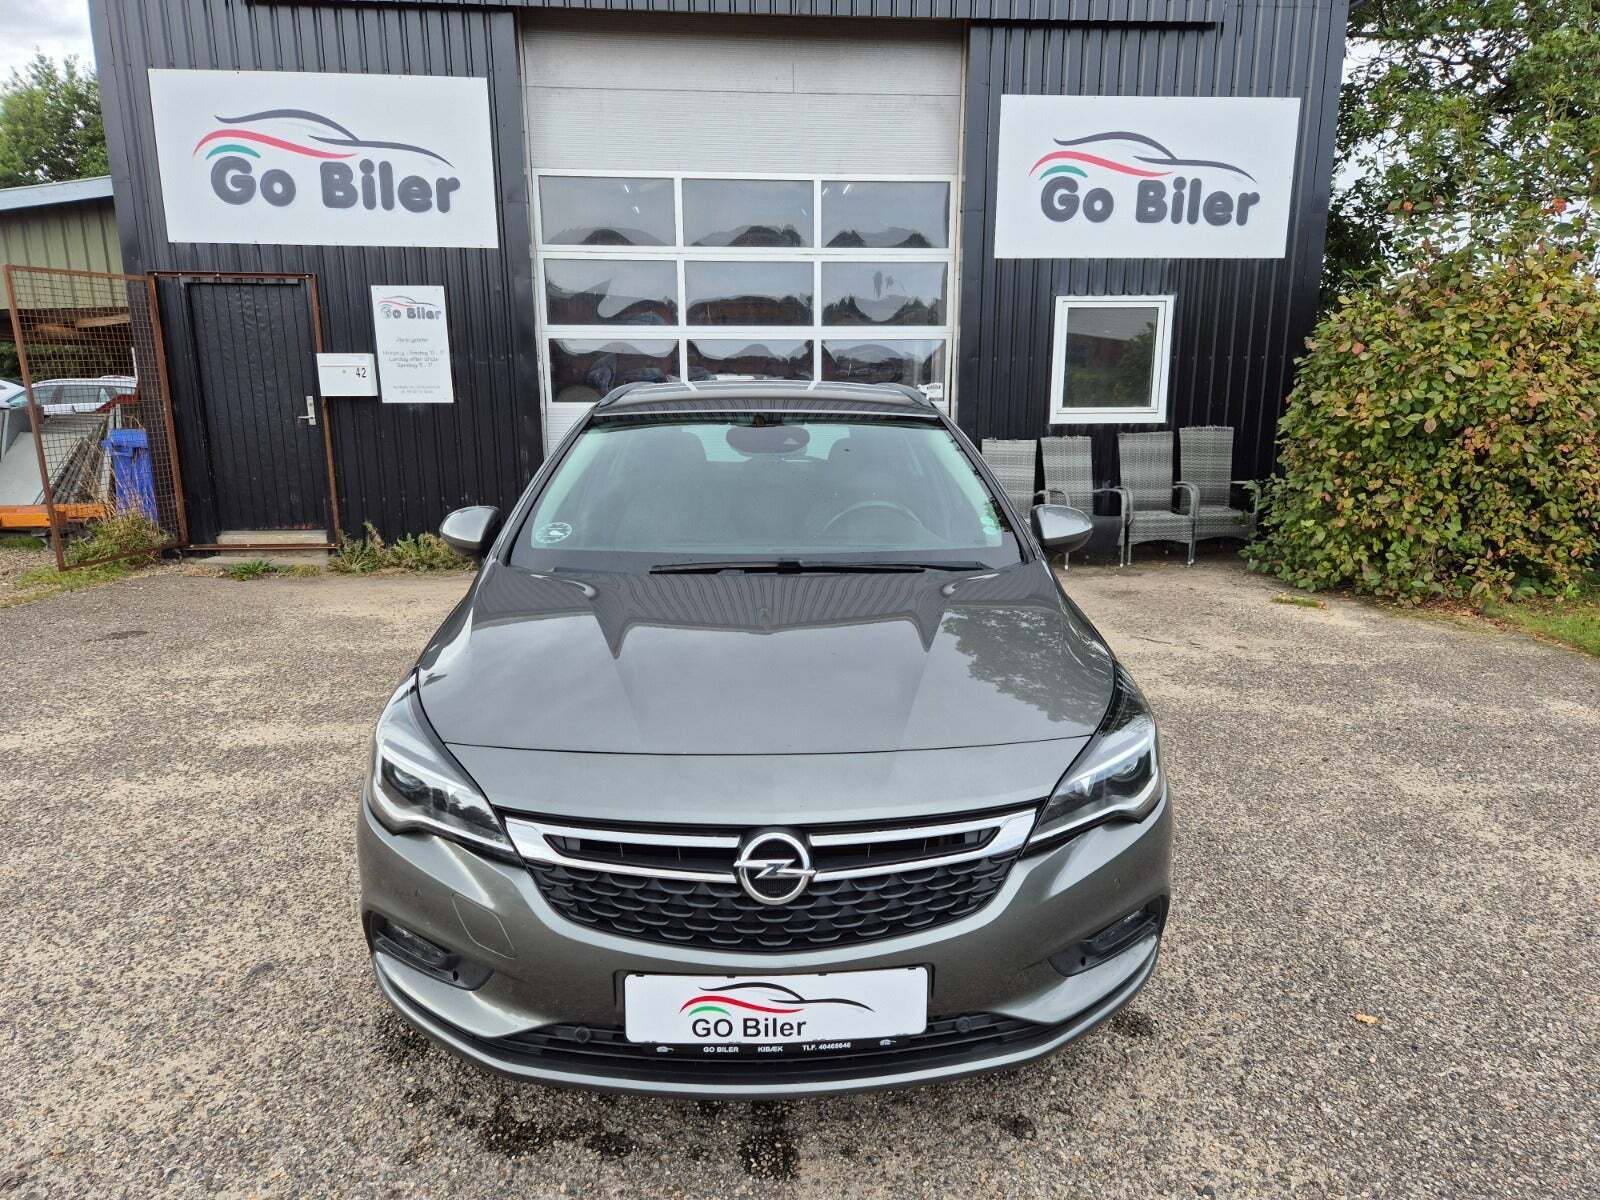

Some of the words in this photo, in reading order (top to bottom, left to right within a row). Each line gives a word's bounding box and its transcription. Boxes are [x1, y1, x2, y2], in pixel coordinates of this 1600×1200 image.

[211, 156, 296, 207] Go
[320, 159, 461, 213] Biler
[1041, 176, 1114, 223] Go
[1135, 177, 1260, 226] Biler
[406, 307, 441, 320] Biler
[355, 367, 367, 378] 42
[692, 1018, 733, 1038] GO
[742, 1017, 807, 1038] Biler
[757, 1045, 783, 1053] KIBÆK
[802, 1044, 817, 1052] TLF.
